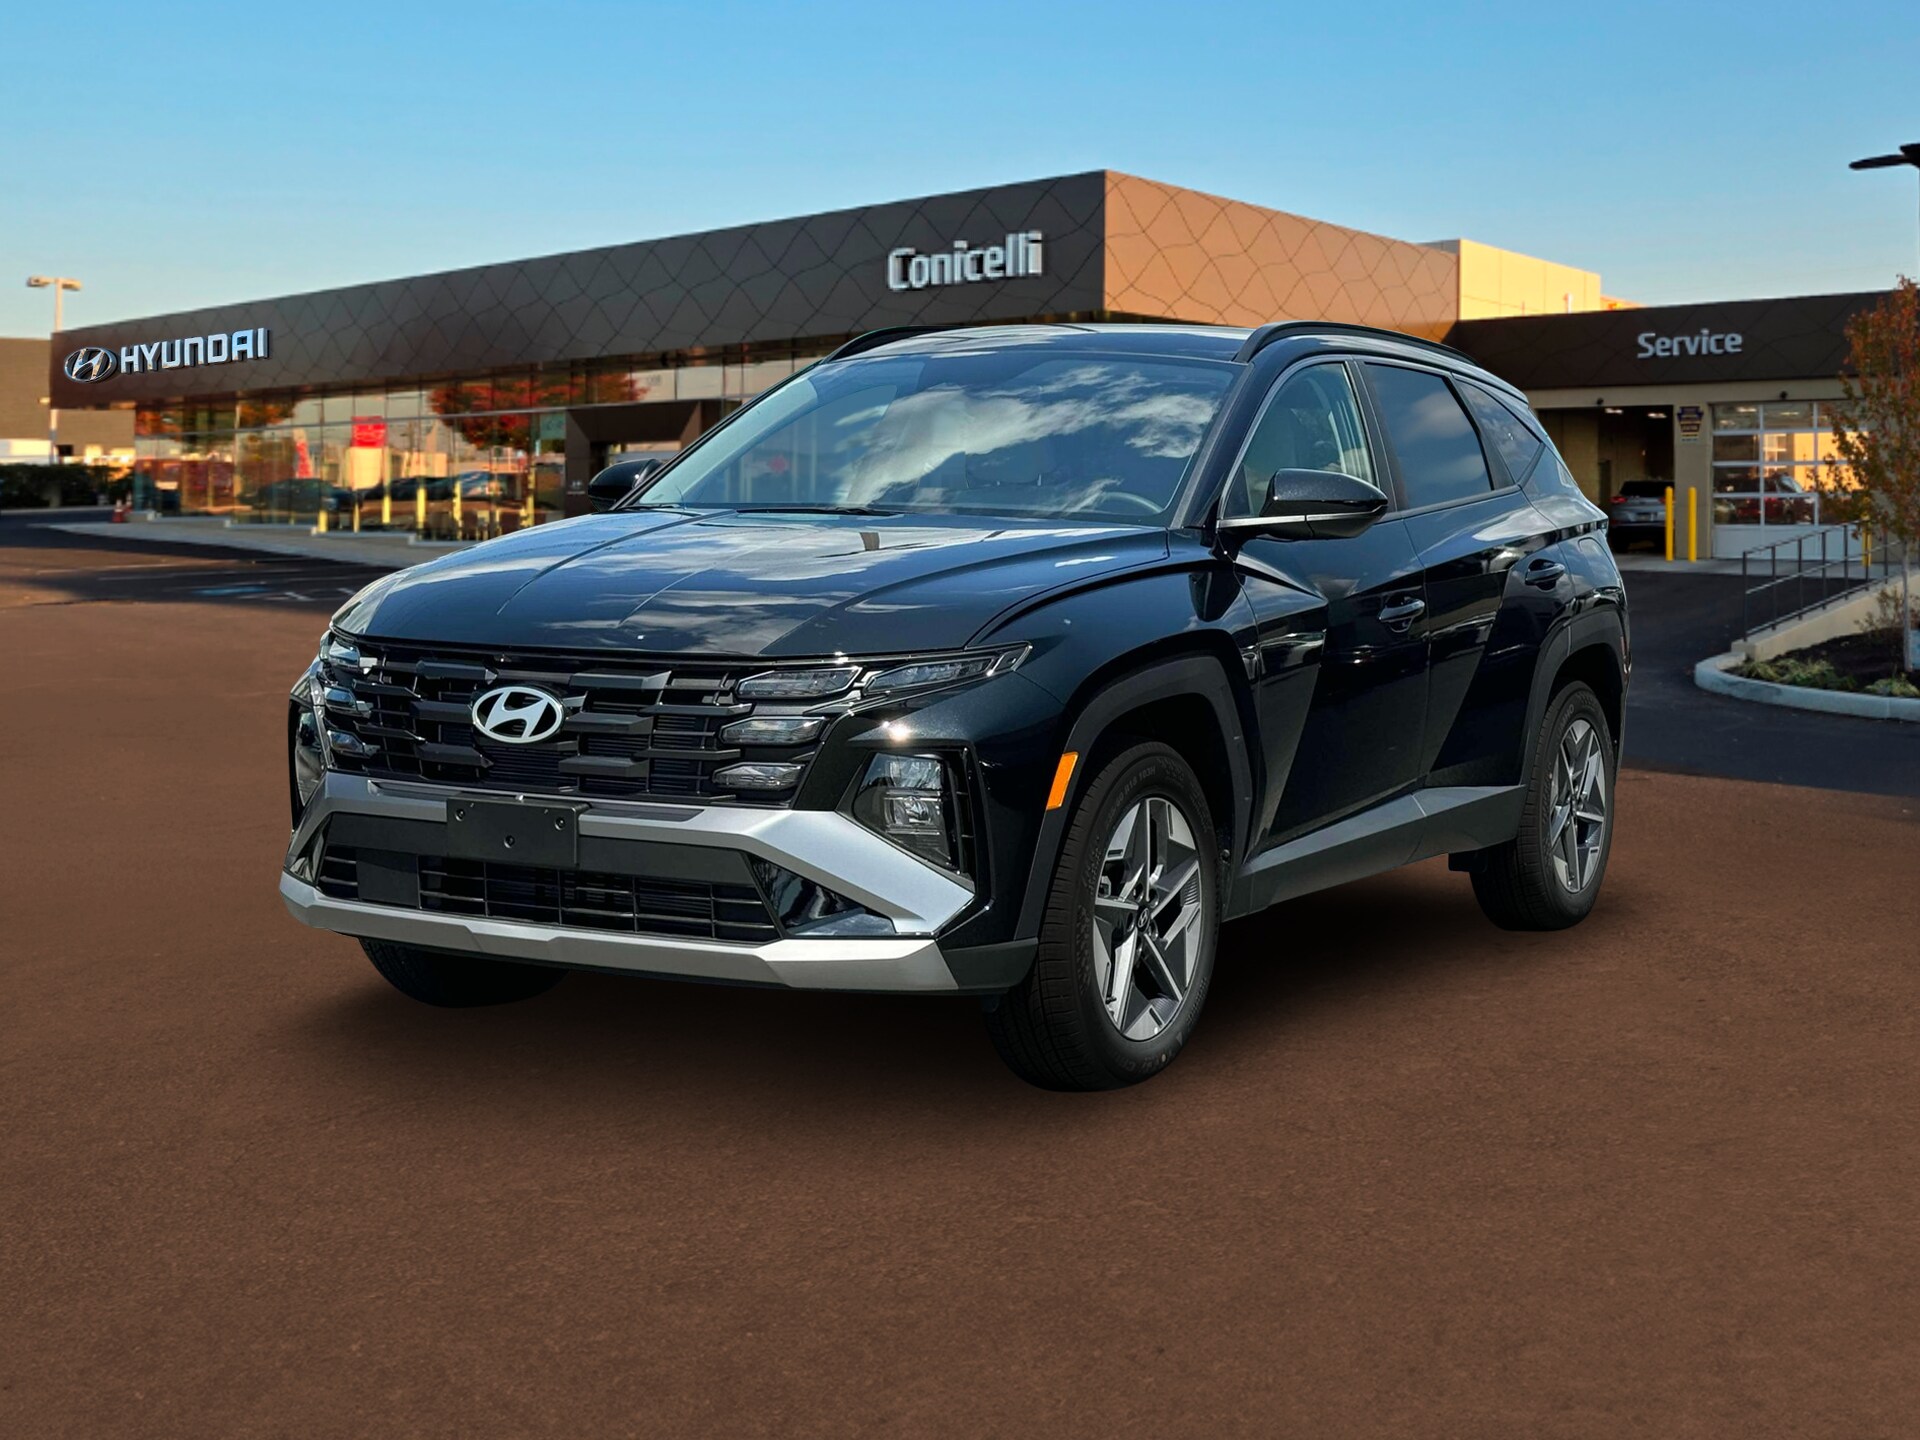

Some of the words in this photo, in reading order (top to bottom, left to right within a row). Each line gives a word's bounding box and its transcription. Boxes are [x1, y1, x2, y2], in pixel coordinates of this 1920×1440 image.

[888, 230, 1043, 290] Conicelli
[120, 327, 268, 374] HYUNDAI
[1637, 328, 1743, 358] Service
